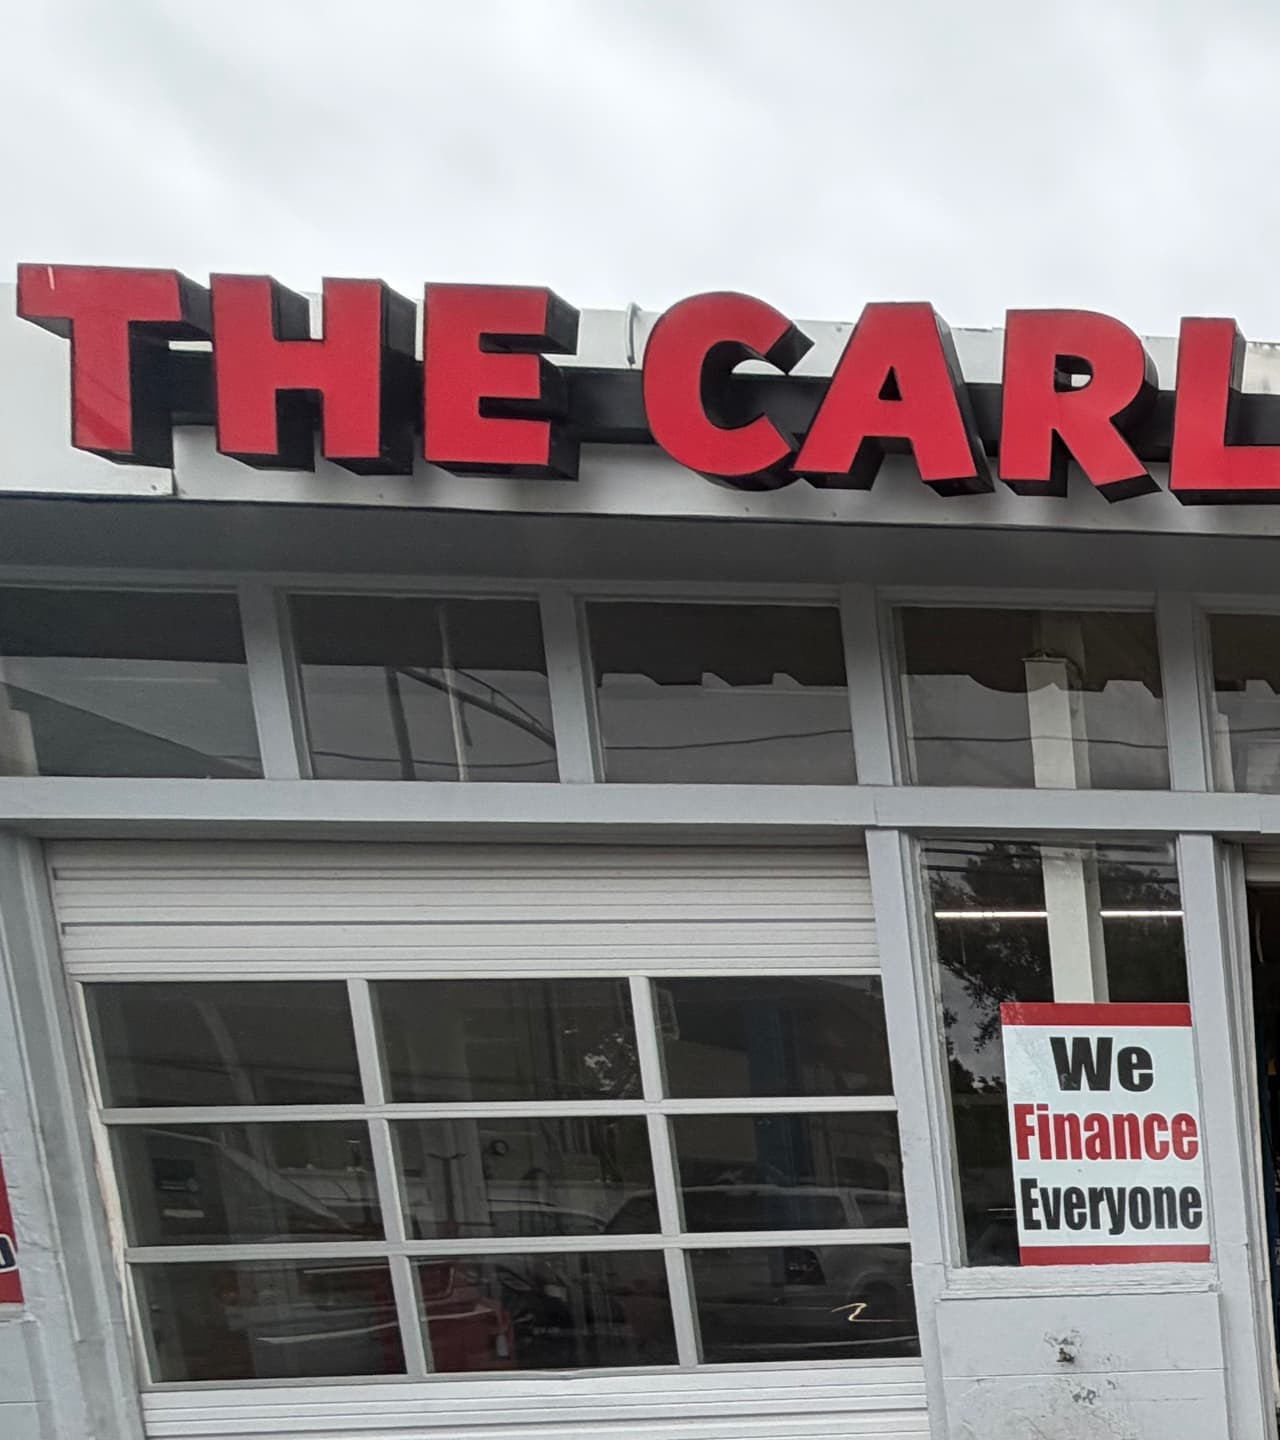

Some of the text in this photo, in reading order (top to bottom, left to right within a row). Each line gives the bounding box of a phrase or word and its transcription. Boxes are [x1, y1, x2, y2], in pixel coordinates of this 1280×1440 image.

[17, 263, 560, 470] THE
[1050, 1036, 1154, 1092] We
[1014, 1103, 1199, 1161] Finance
[1020, 1178, 1203, 1236] Everyone
